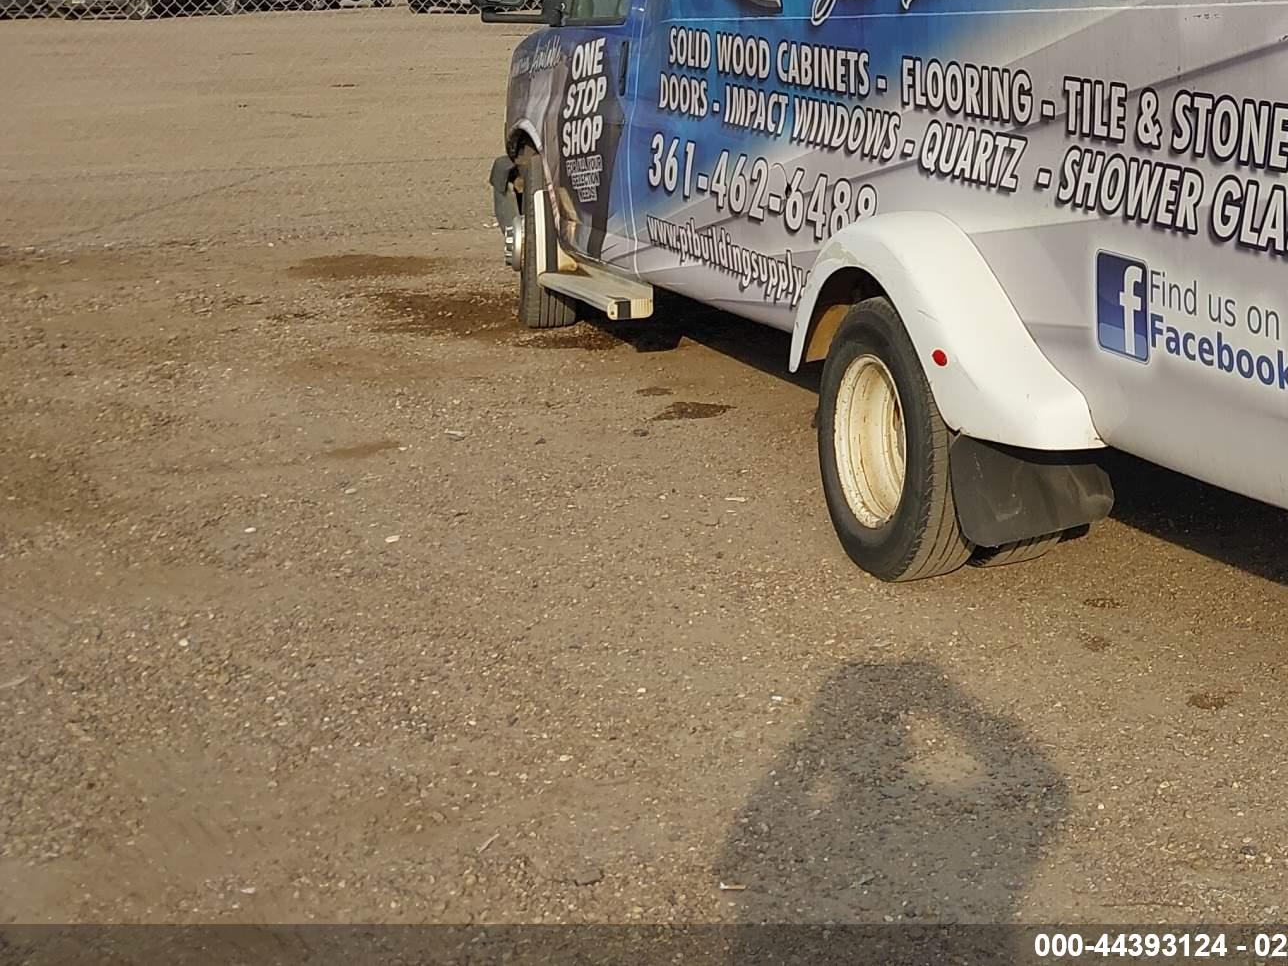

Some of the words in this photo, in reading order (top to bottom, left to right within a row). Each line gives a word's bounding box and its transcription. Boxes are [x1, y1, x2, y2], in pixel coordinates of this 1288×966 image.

[571, 38, 606, 80] ONE
[668, 25, 712, 70] SOLID
[716, 32, 771, 80] WOOD
[776, 42, 871, 97] CABINETS
[902, 56, 1033, 125] FLOORING
[1064, 76, 1128, 144] TILE
[1137, 87, 1163, 149] &
[563, 76, 608, 119] STOP
[562, 115, 604, 157] SHOP
[659, 72, 708, 117] DOORS
[724, 84, 789, 136] IMPACT
[791, 96, 901, 161] WINDOWS
[920, 119, 1028, 192] QUARTZ
[1057, 146, 1204, 234] SHOWER
[1150, 270, 1198, 315] Find
[1208, 293, 1237, 328] us
[1247, 304, 1281, 340] on
